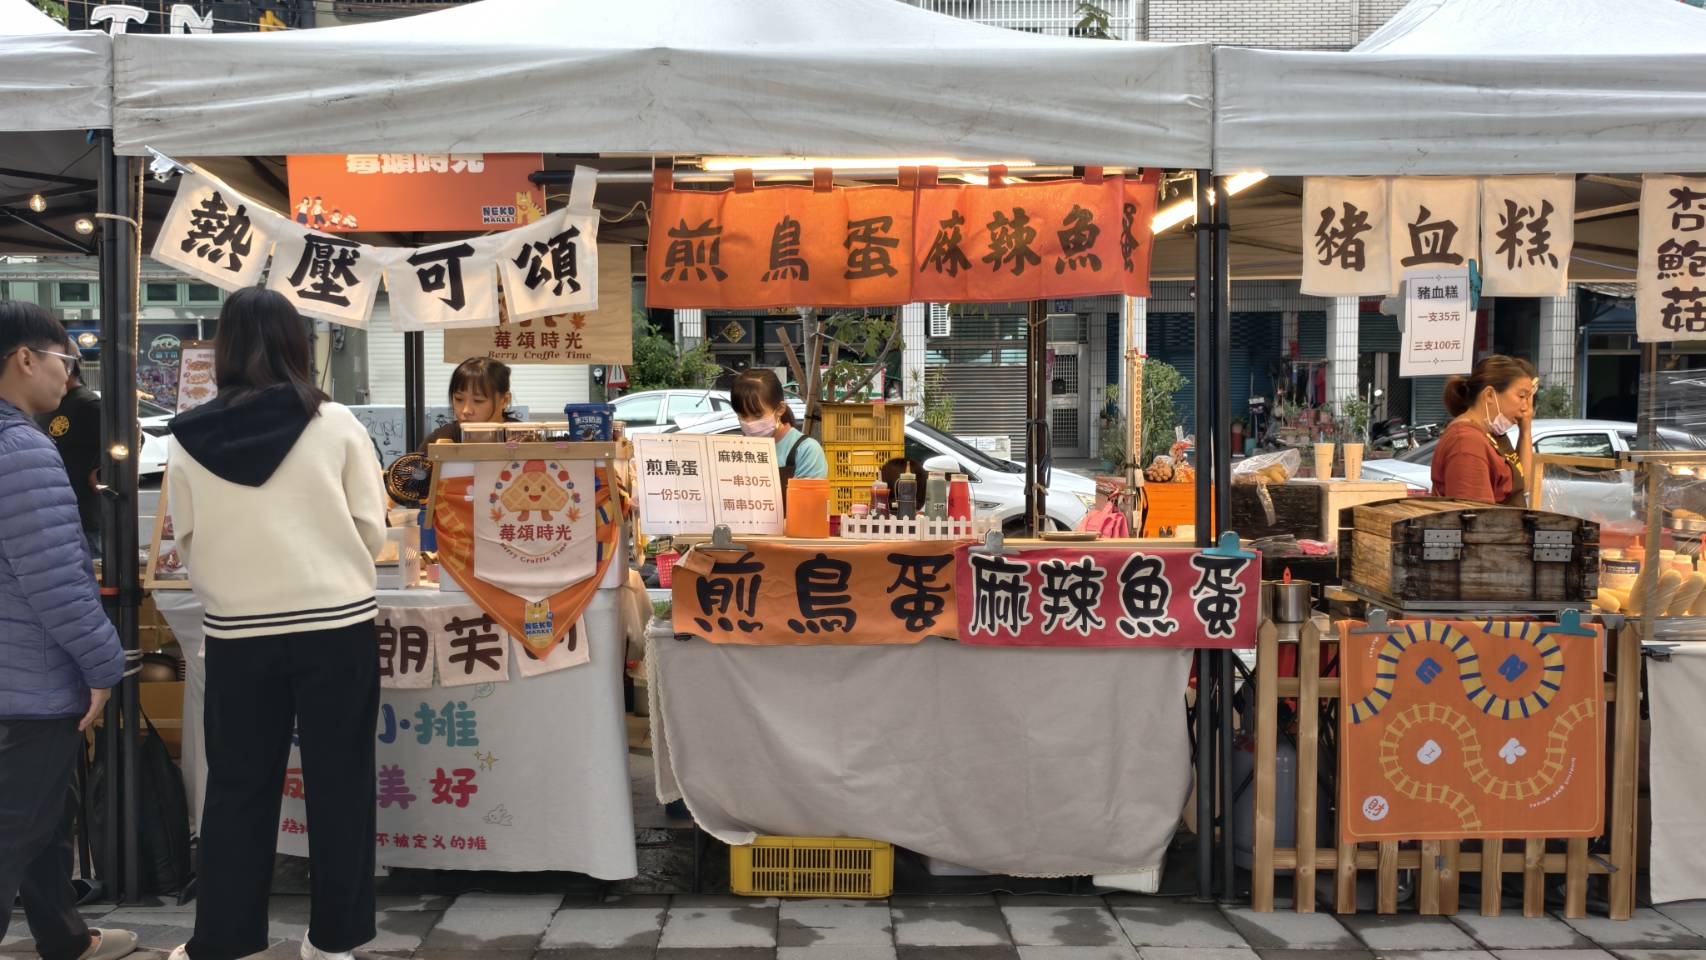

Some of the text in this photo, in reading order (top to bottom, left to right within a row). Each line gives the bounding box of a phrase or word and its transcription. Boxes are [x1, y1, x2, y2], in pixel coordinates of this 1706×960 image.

[482, 206, 515, 216] NEKO
[483, 216, 515, 224] MARKET
[1314, 199, 1559, 272] 豬血糕
[181, 191, 581, 311] 熱壓可頌
[660, 214, 900, 282] 煎鳥蛋
[1657, 186, 1706, 333] 杏鮑菇
[1417, 285, 1459, 299] 豬血糕
[1418, 311, 1460, 322] 一支35元
[494, 330, 583, 349] 莓頌時光
[1413, 340, 1461, 351] 三支100元
[488, 350, 592, 360] Berry Croffle Time
[718, 449, 769, 464] 麻辣魚蛋
[646, 459, 699, 476] 煎鳥蛋
[720, 475, 771, 488] 一串30元
[647, 488, 702, 501] 一份50元
[723, 498, 775, 512] 兩串50元
[499, 523, 572, 541] 莓頌時光
[694, 551, 955, 634] 煎鳥蛋
[969, 553, 1250, 638] 麻辣魚蛋
[376, 613, 577, 678] 朗芙
[376, 765, 478, 809] 美好
